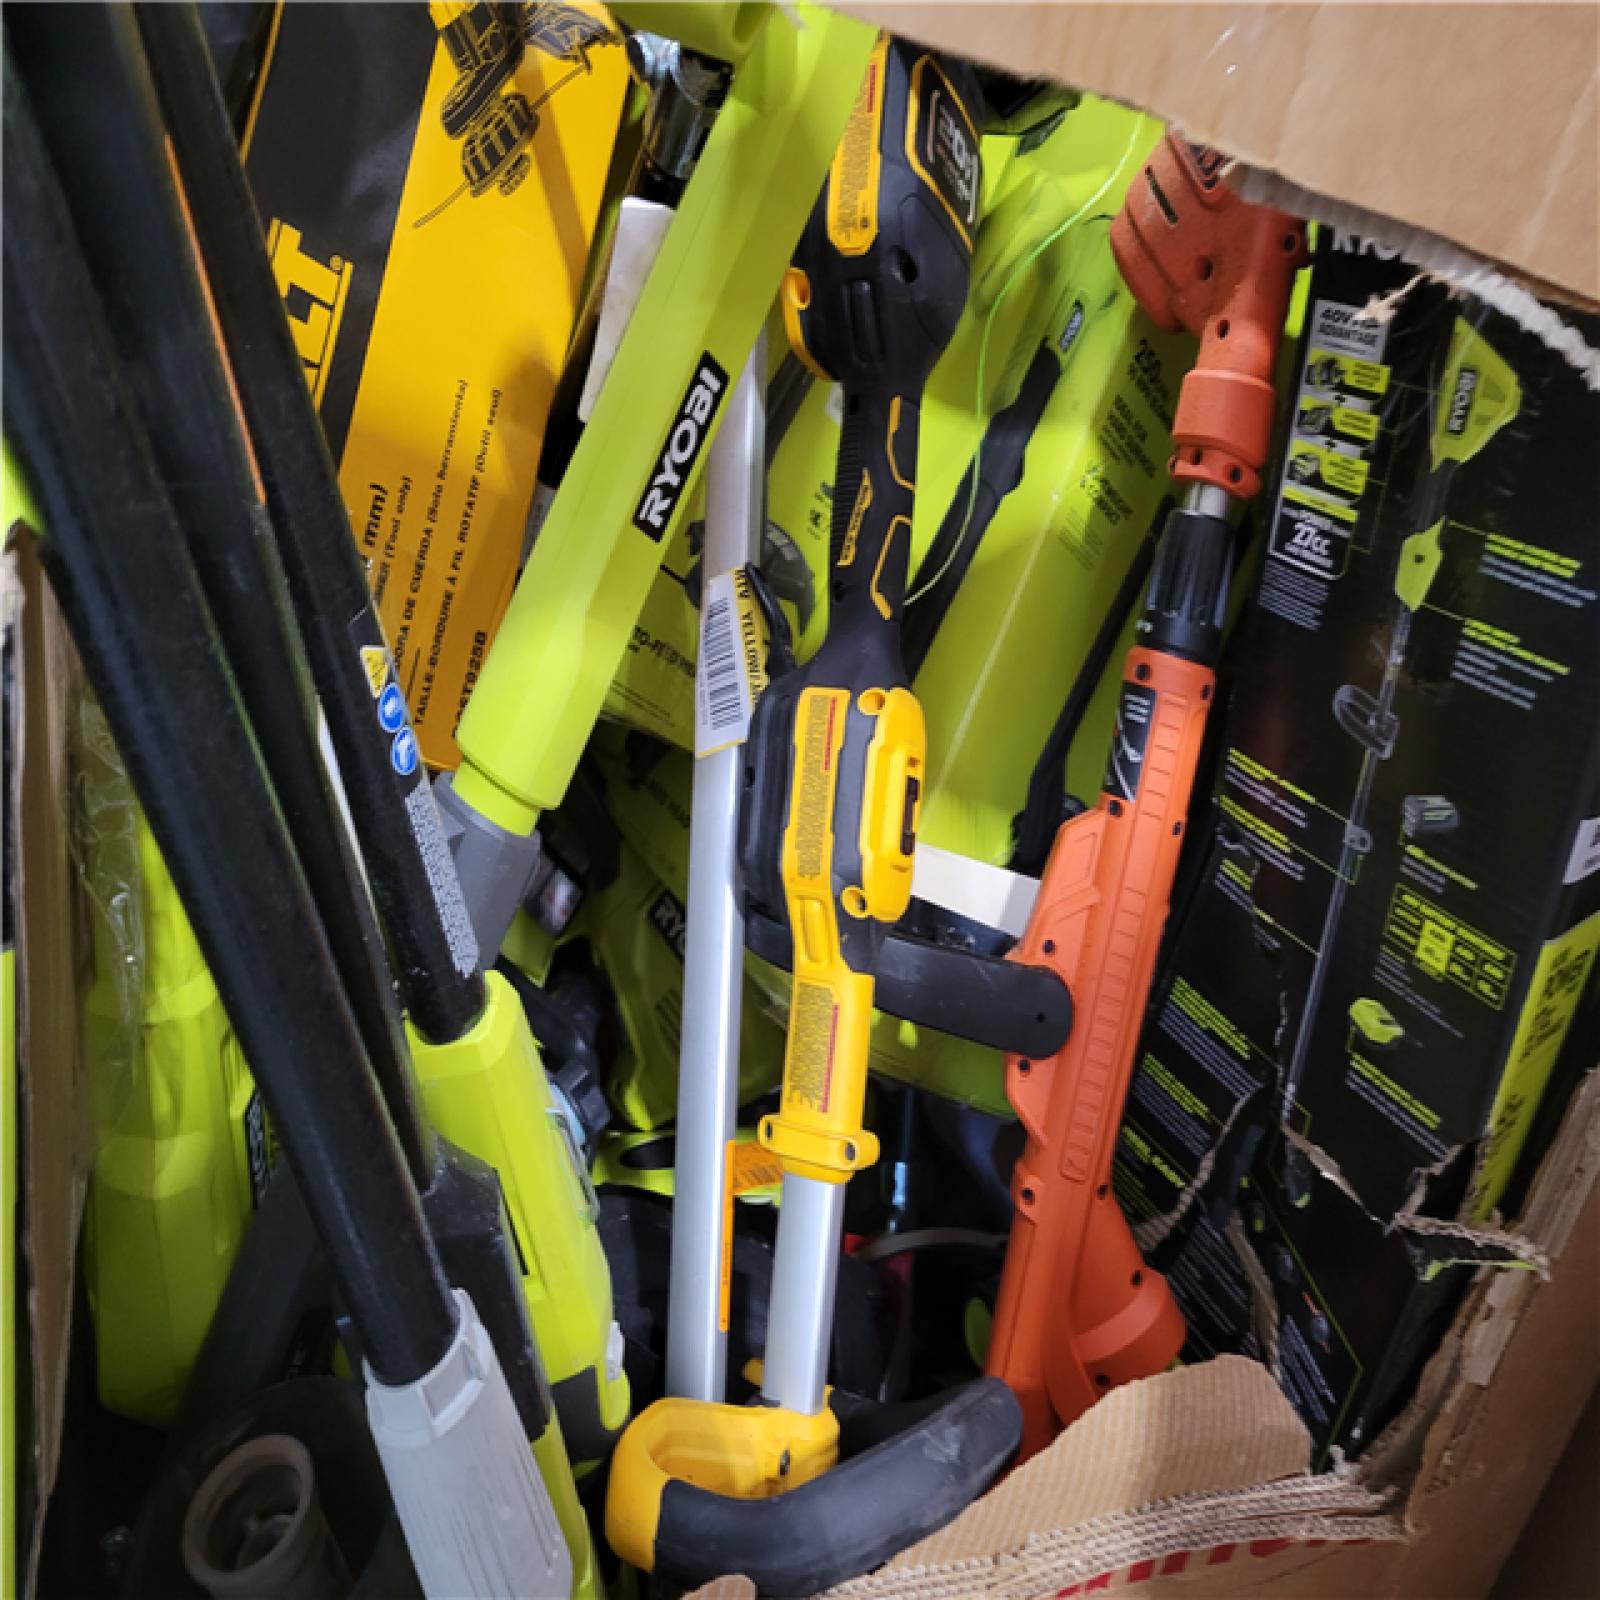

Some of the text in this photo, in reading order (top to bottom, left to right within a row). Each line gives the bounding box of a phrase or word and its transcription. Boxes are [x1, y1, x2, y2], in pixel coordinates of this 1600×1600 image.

[638, 367, 721, 528] RYOBI
[364, 482, 389, 547] mm)
[456, 474, 480, 543] ROTATIF
[402, 597, 416, 621] DE
[409, 528, 434, 593] CUERDA
[450, 548, 465, 570] FIL
[413, 590, 454, 725] TAILLE-BORDURE
